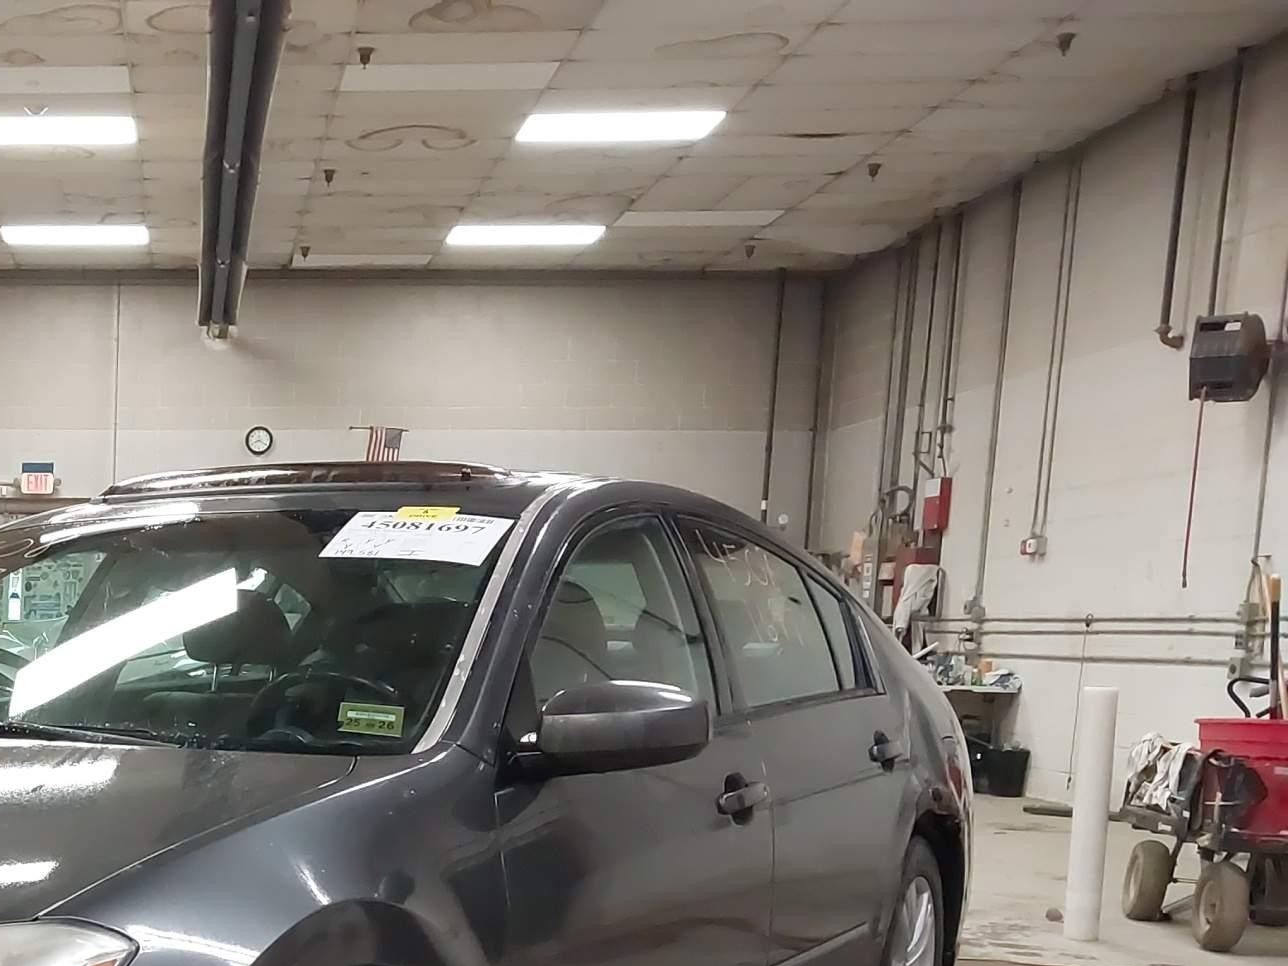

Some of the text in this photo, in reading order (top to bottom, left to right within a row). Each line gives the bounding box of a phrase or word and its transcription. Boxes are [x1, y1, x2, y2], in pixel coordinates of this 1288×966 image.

[27, 474, 49, 491] EXIT
[361, 520, 487, 535] 45081697
[378, 720, 395, 730] 26
